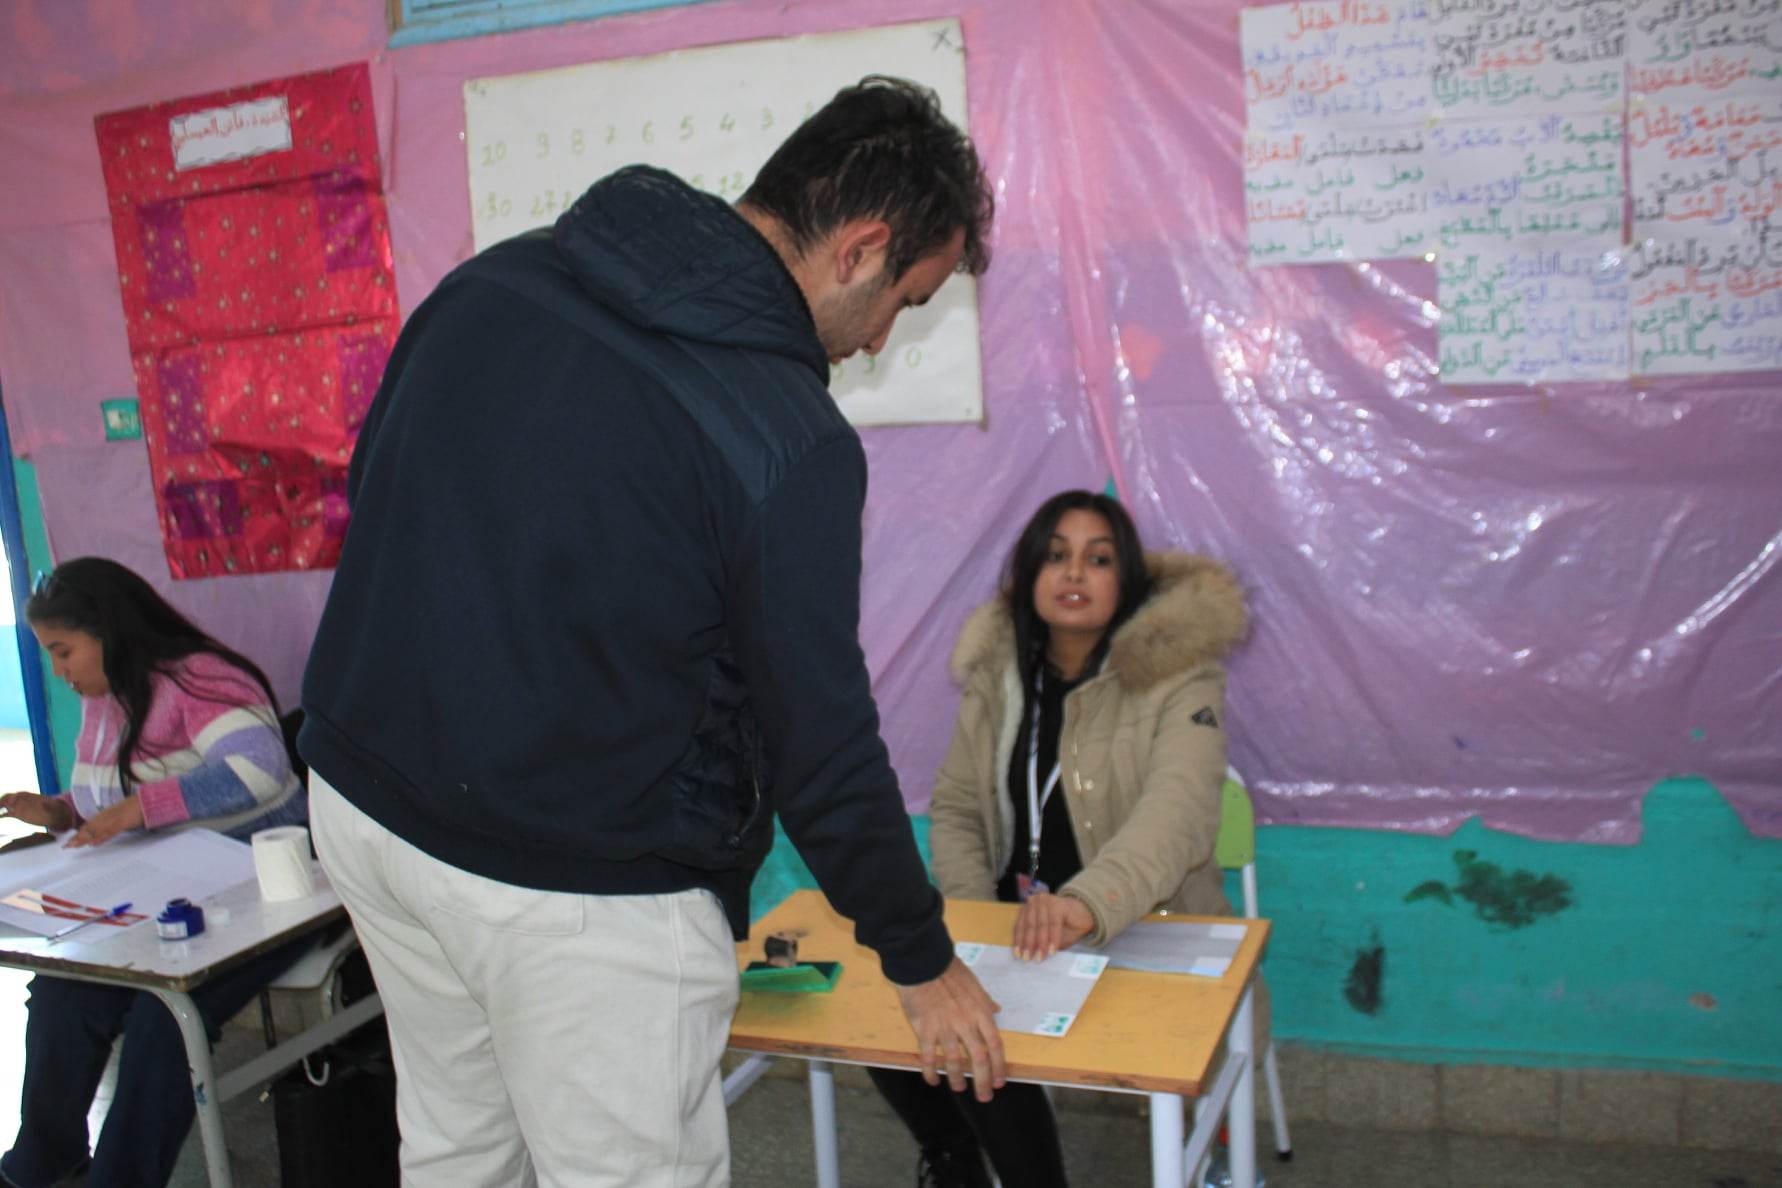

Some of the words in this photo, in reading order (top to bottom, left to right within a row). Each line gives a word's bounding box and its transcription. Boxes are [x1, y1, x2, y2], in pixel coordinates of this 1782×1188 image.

[641, 119, 655, 143] 6
[679, 115, 695, 141] 5
[719, 113, 736, 133] 4
[761, 107, 775, 131] 3
